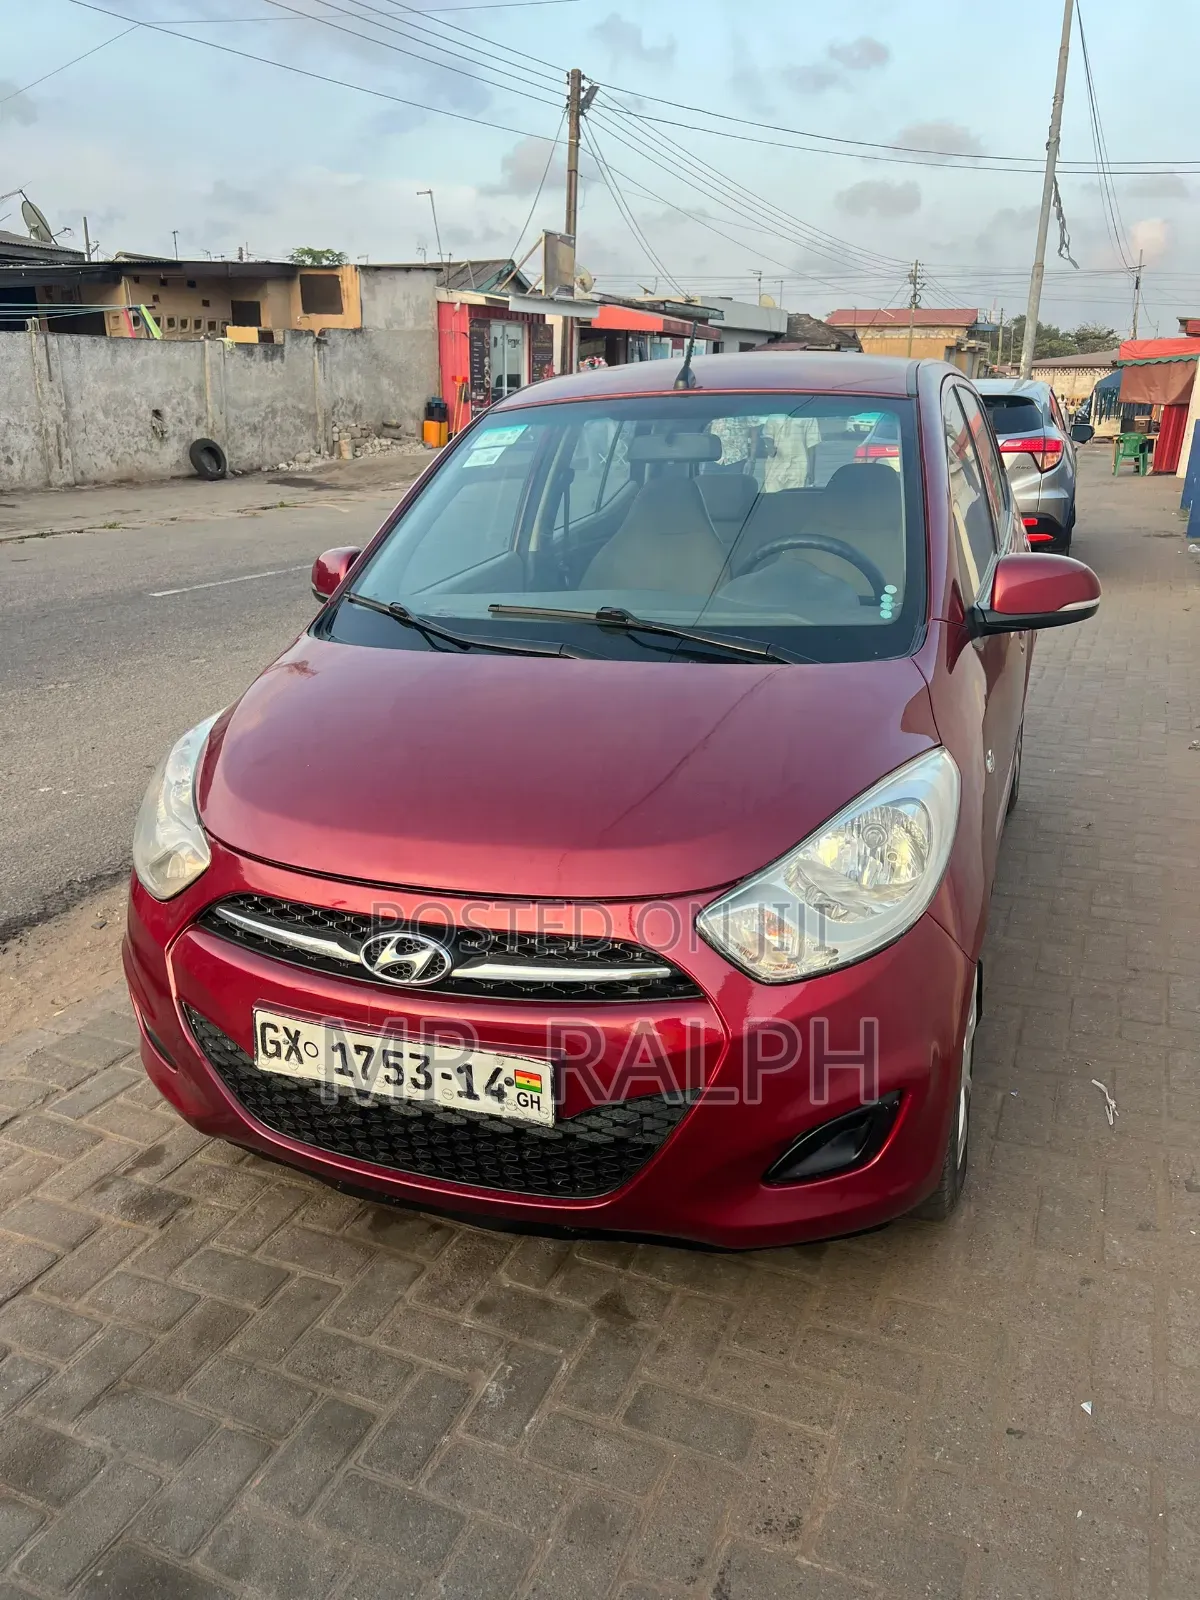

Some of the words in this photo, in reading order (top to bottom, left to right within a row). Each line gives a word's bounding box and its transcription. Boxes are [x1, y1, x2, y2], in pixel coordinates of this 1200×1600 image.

[259, 1021, 304, 1064] GX
[331, 1042, 507, 1105] 1753-14
[517, 1091, 541, 1111] GH
